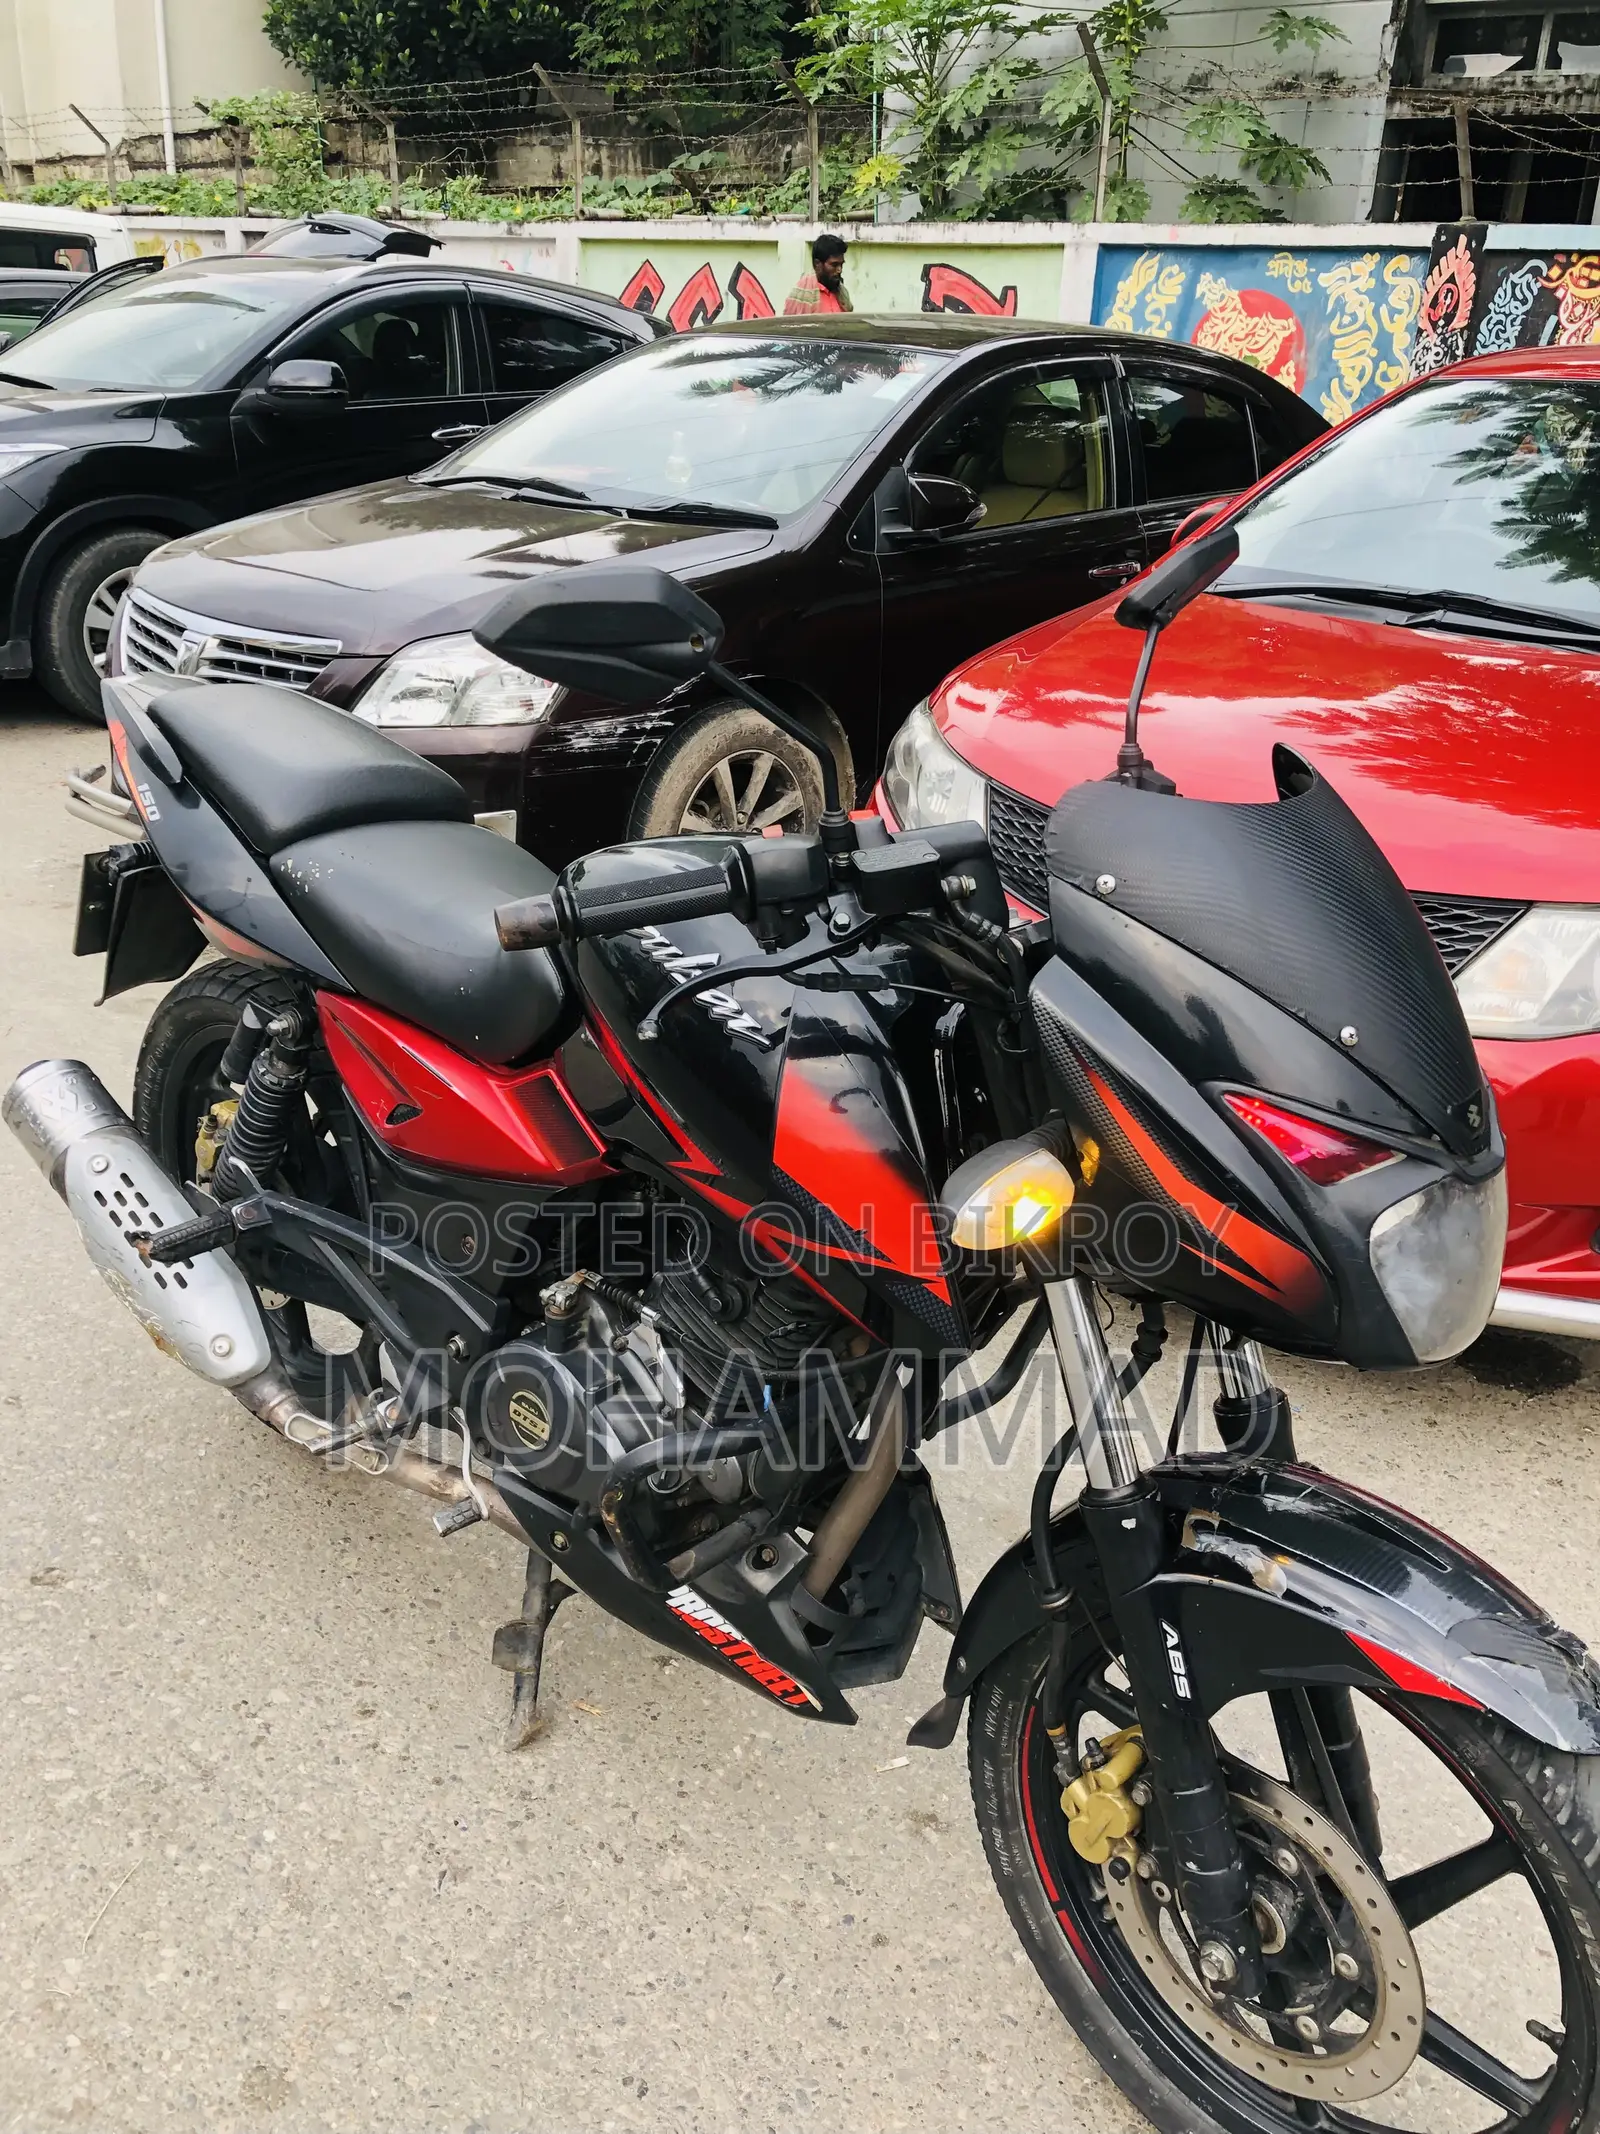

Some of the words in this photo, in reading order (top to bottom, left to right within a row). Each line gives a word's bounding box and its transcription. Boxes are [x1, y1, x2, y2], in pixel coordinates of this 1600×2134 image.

[136, 782, 161, 822] 150
[624, 925, 774, 1051] ulsar
[521, 1401, 539, 1416] BAJAJ
[1161, 1621, 1192, 1699] ABS
